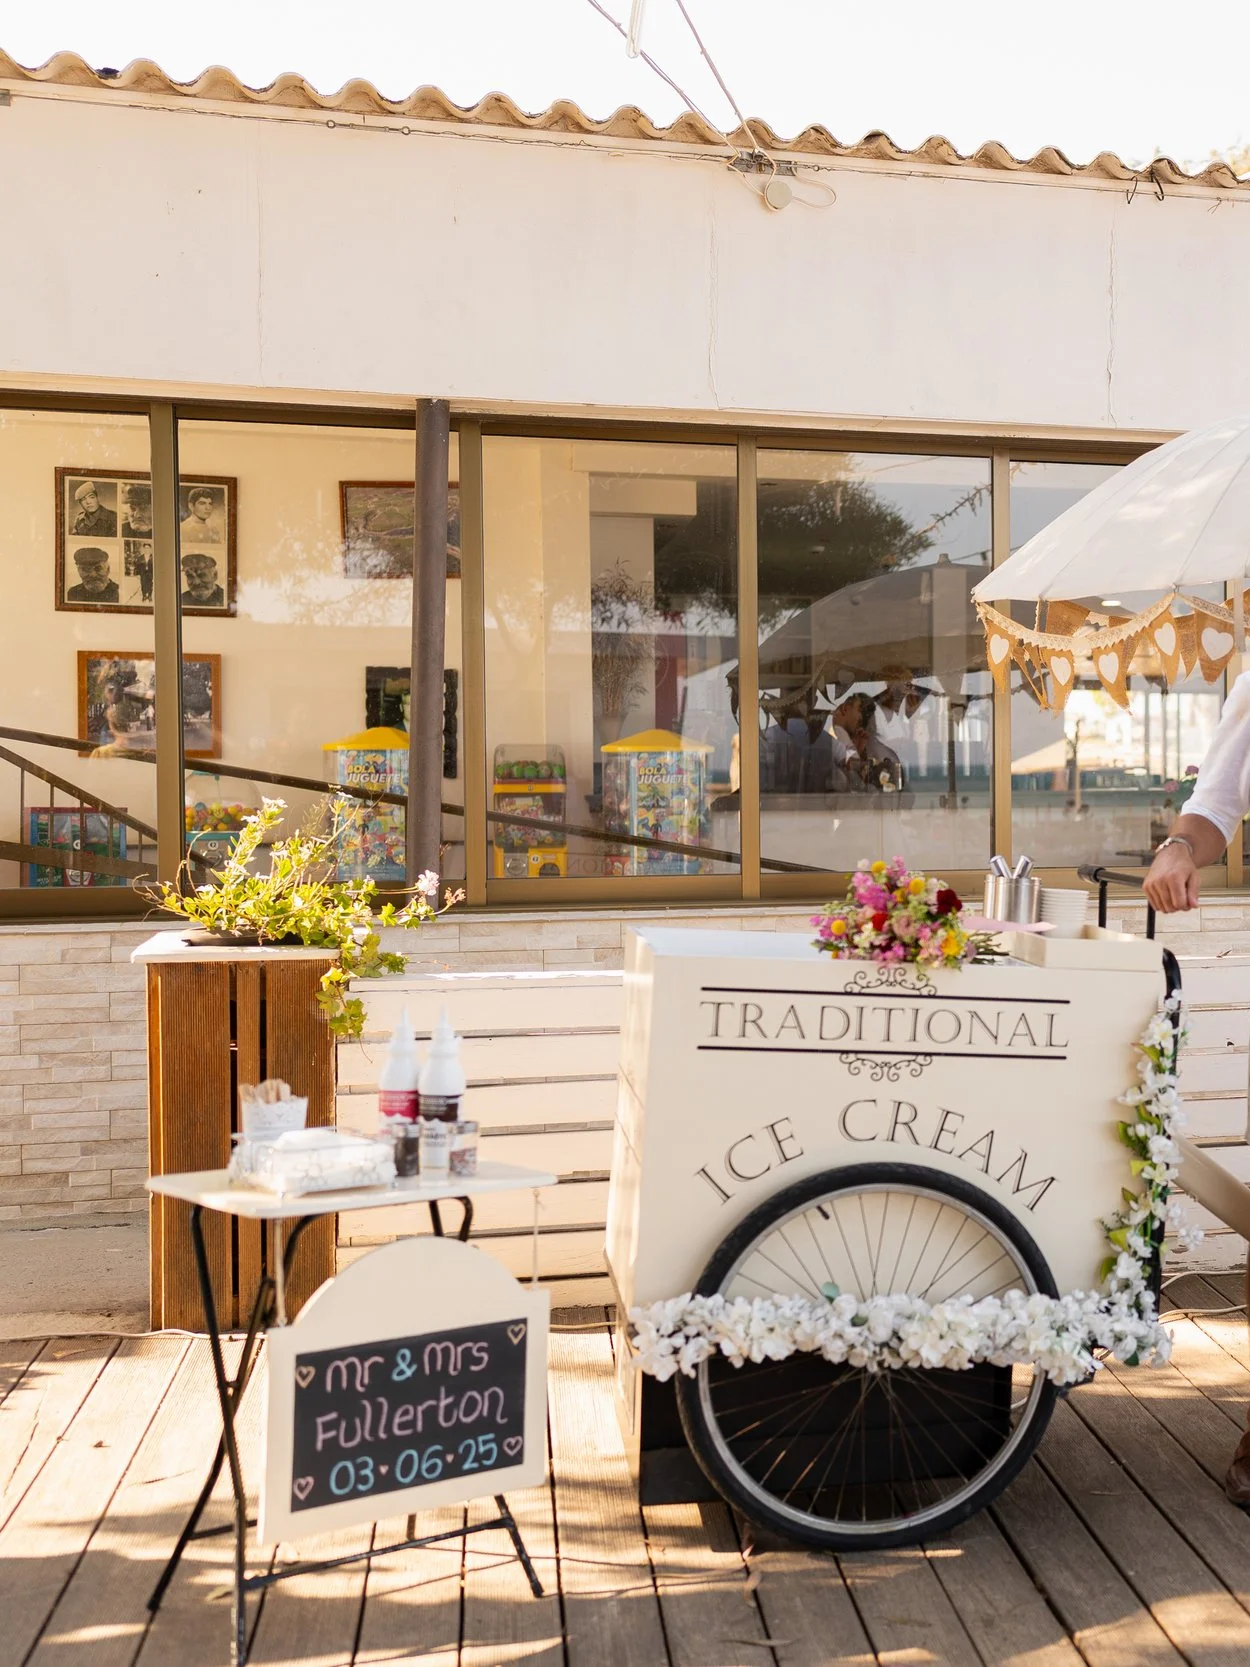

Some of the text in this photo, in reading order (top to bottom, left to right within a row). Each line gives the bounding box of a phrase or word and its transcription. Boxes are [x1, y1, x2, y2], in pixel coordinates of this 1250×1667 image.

[347, 764, 376, 774] BOLA
[347, 772, 401, 783] JUGUETE
[639, 766, 667, 776] BOLA
[699, 1000, 1070, 1049] TRADITIONAL
[694, 1098, 1062, 1213] ICE CREAM
[391, 1348, 418, 1382] &
[315, 1386, 508, 1452] Fullerton
